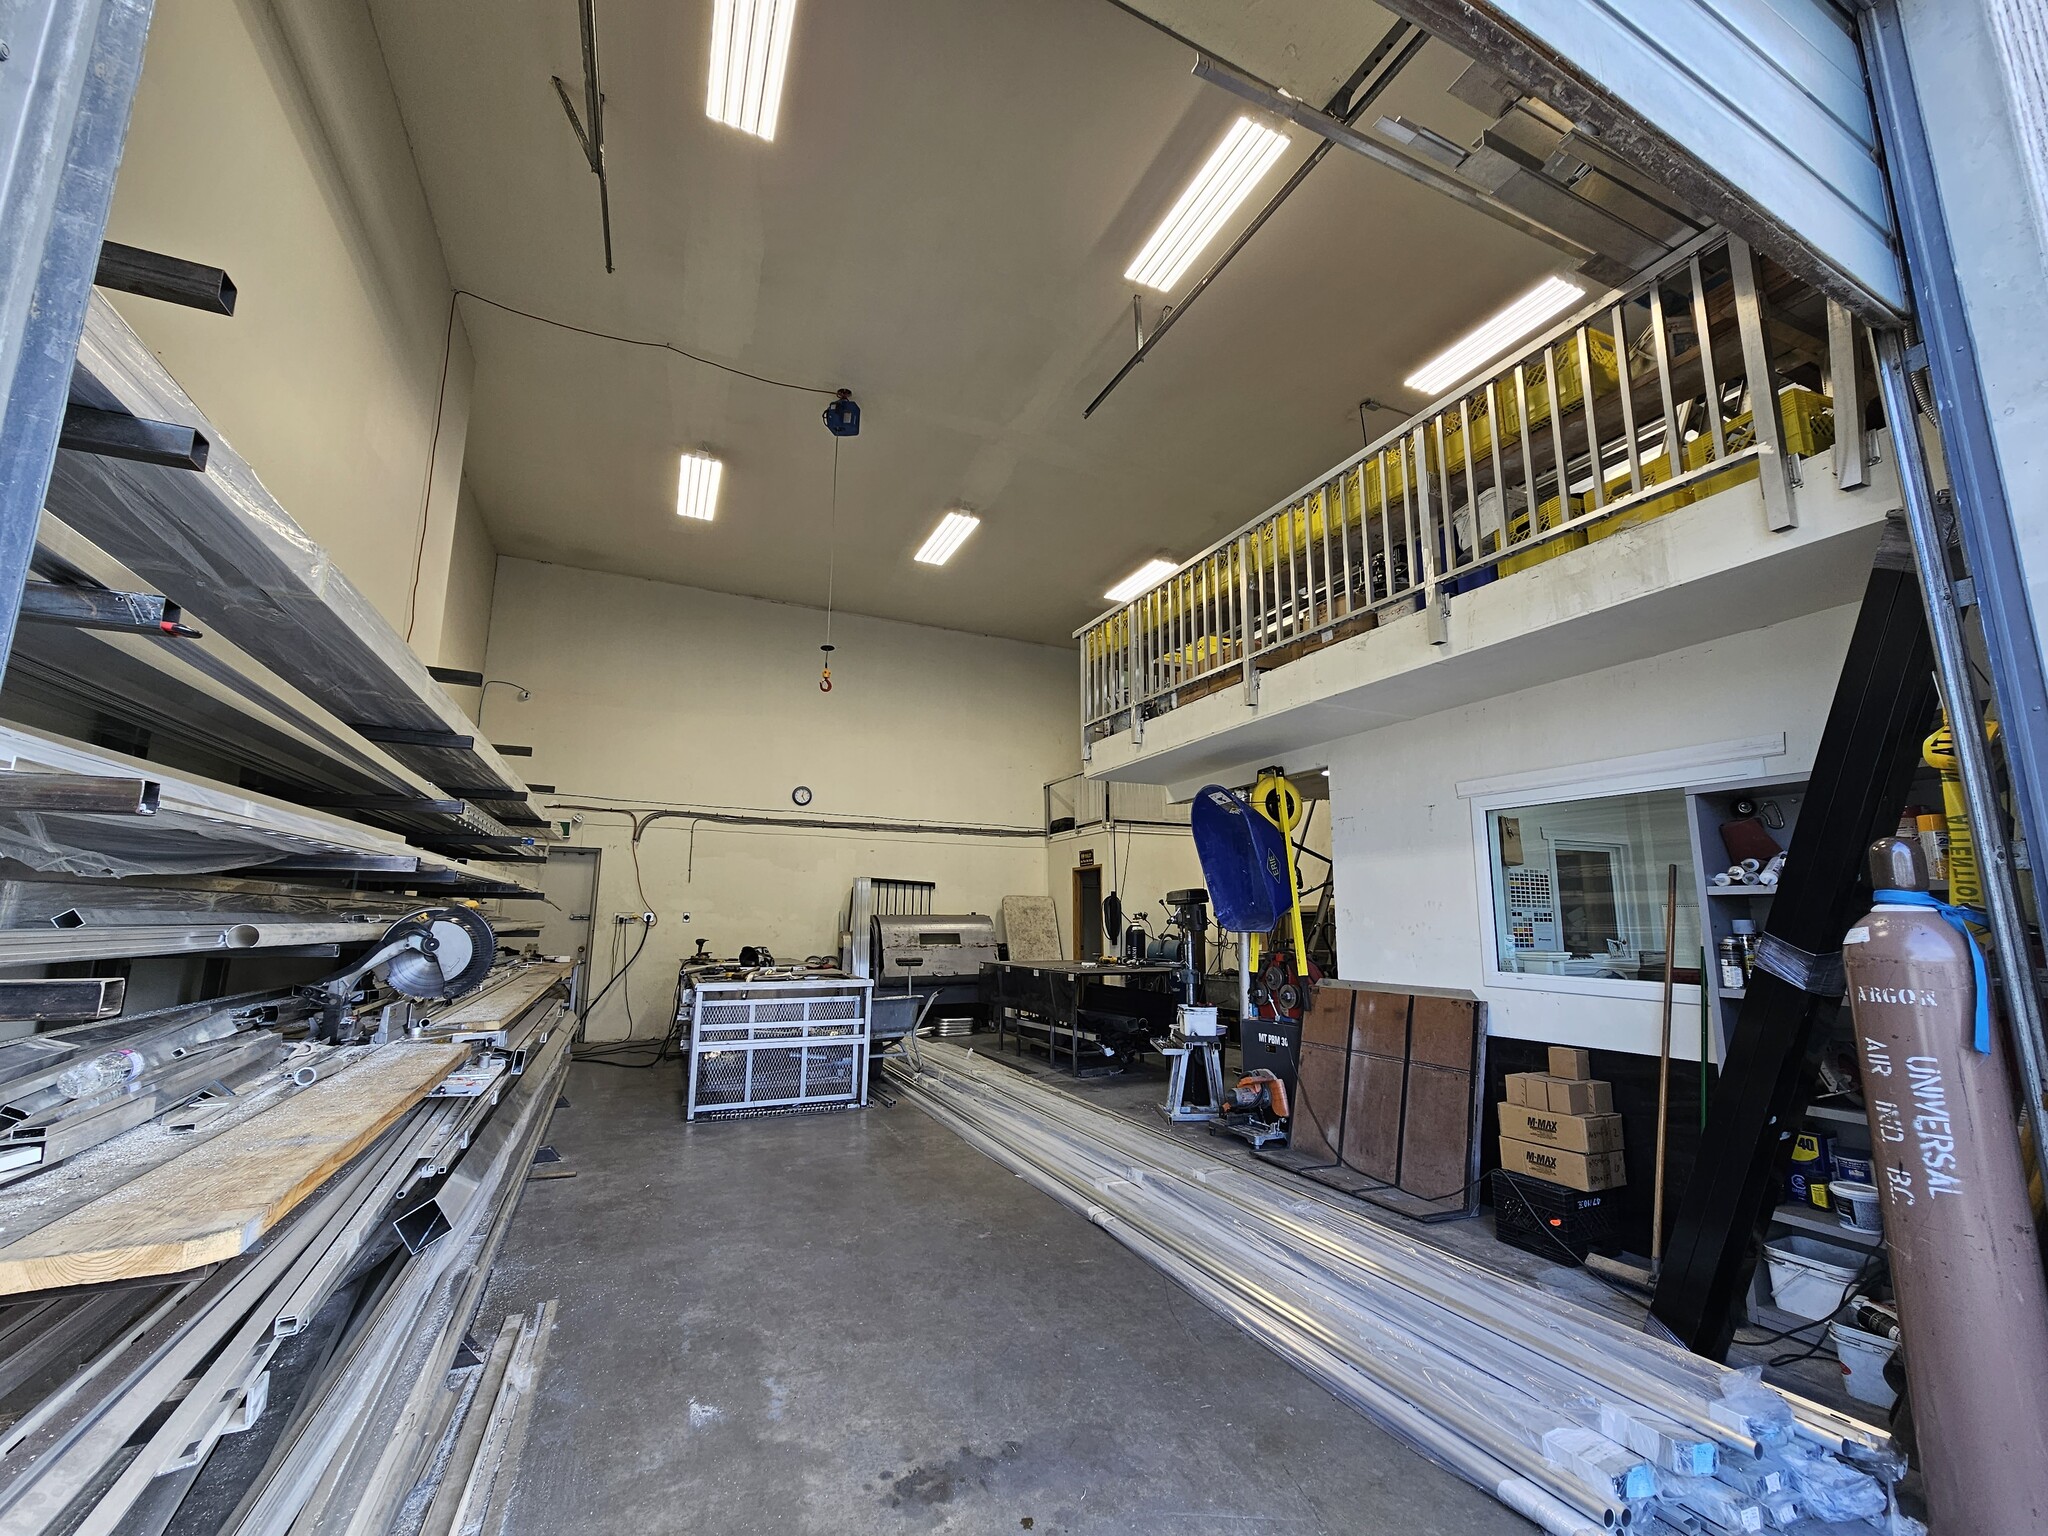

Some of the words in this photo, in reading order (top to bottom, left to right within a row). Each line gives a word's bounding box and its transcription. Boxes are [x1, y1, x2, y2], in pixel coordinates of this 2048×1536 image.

[1268, 855, 1279, 875] ERIE
[1858, 986, 1937, 1007] ARGON
[1258, 1032, 1268, 1043] MT
[1268, 1034, 1281, 1045] PBM
[1865, 1037, 1892, 1077] AIR
[1906, 1056, 1964, 1199] UNIVERSAL
